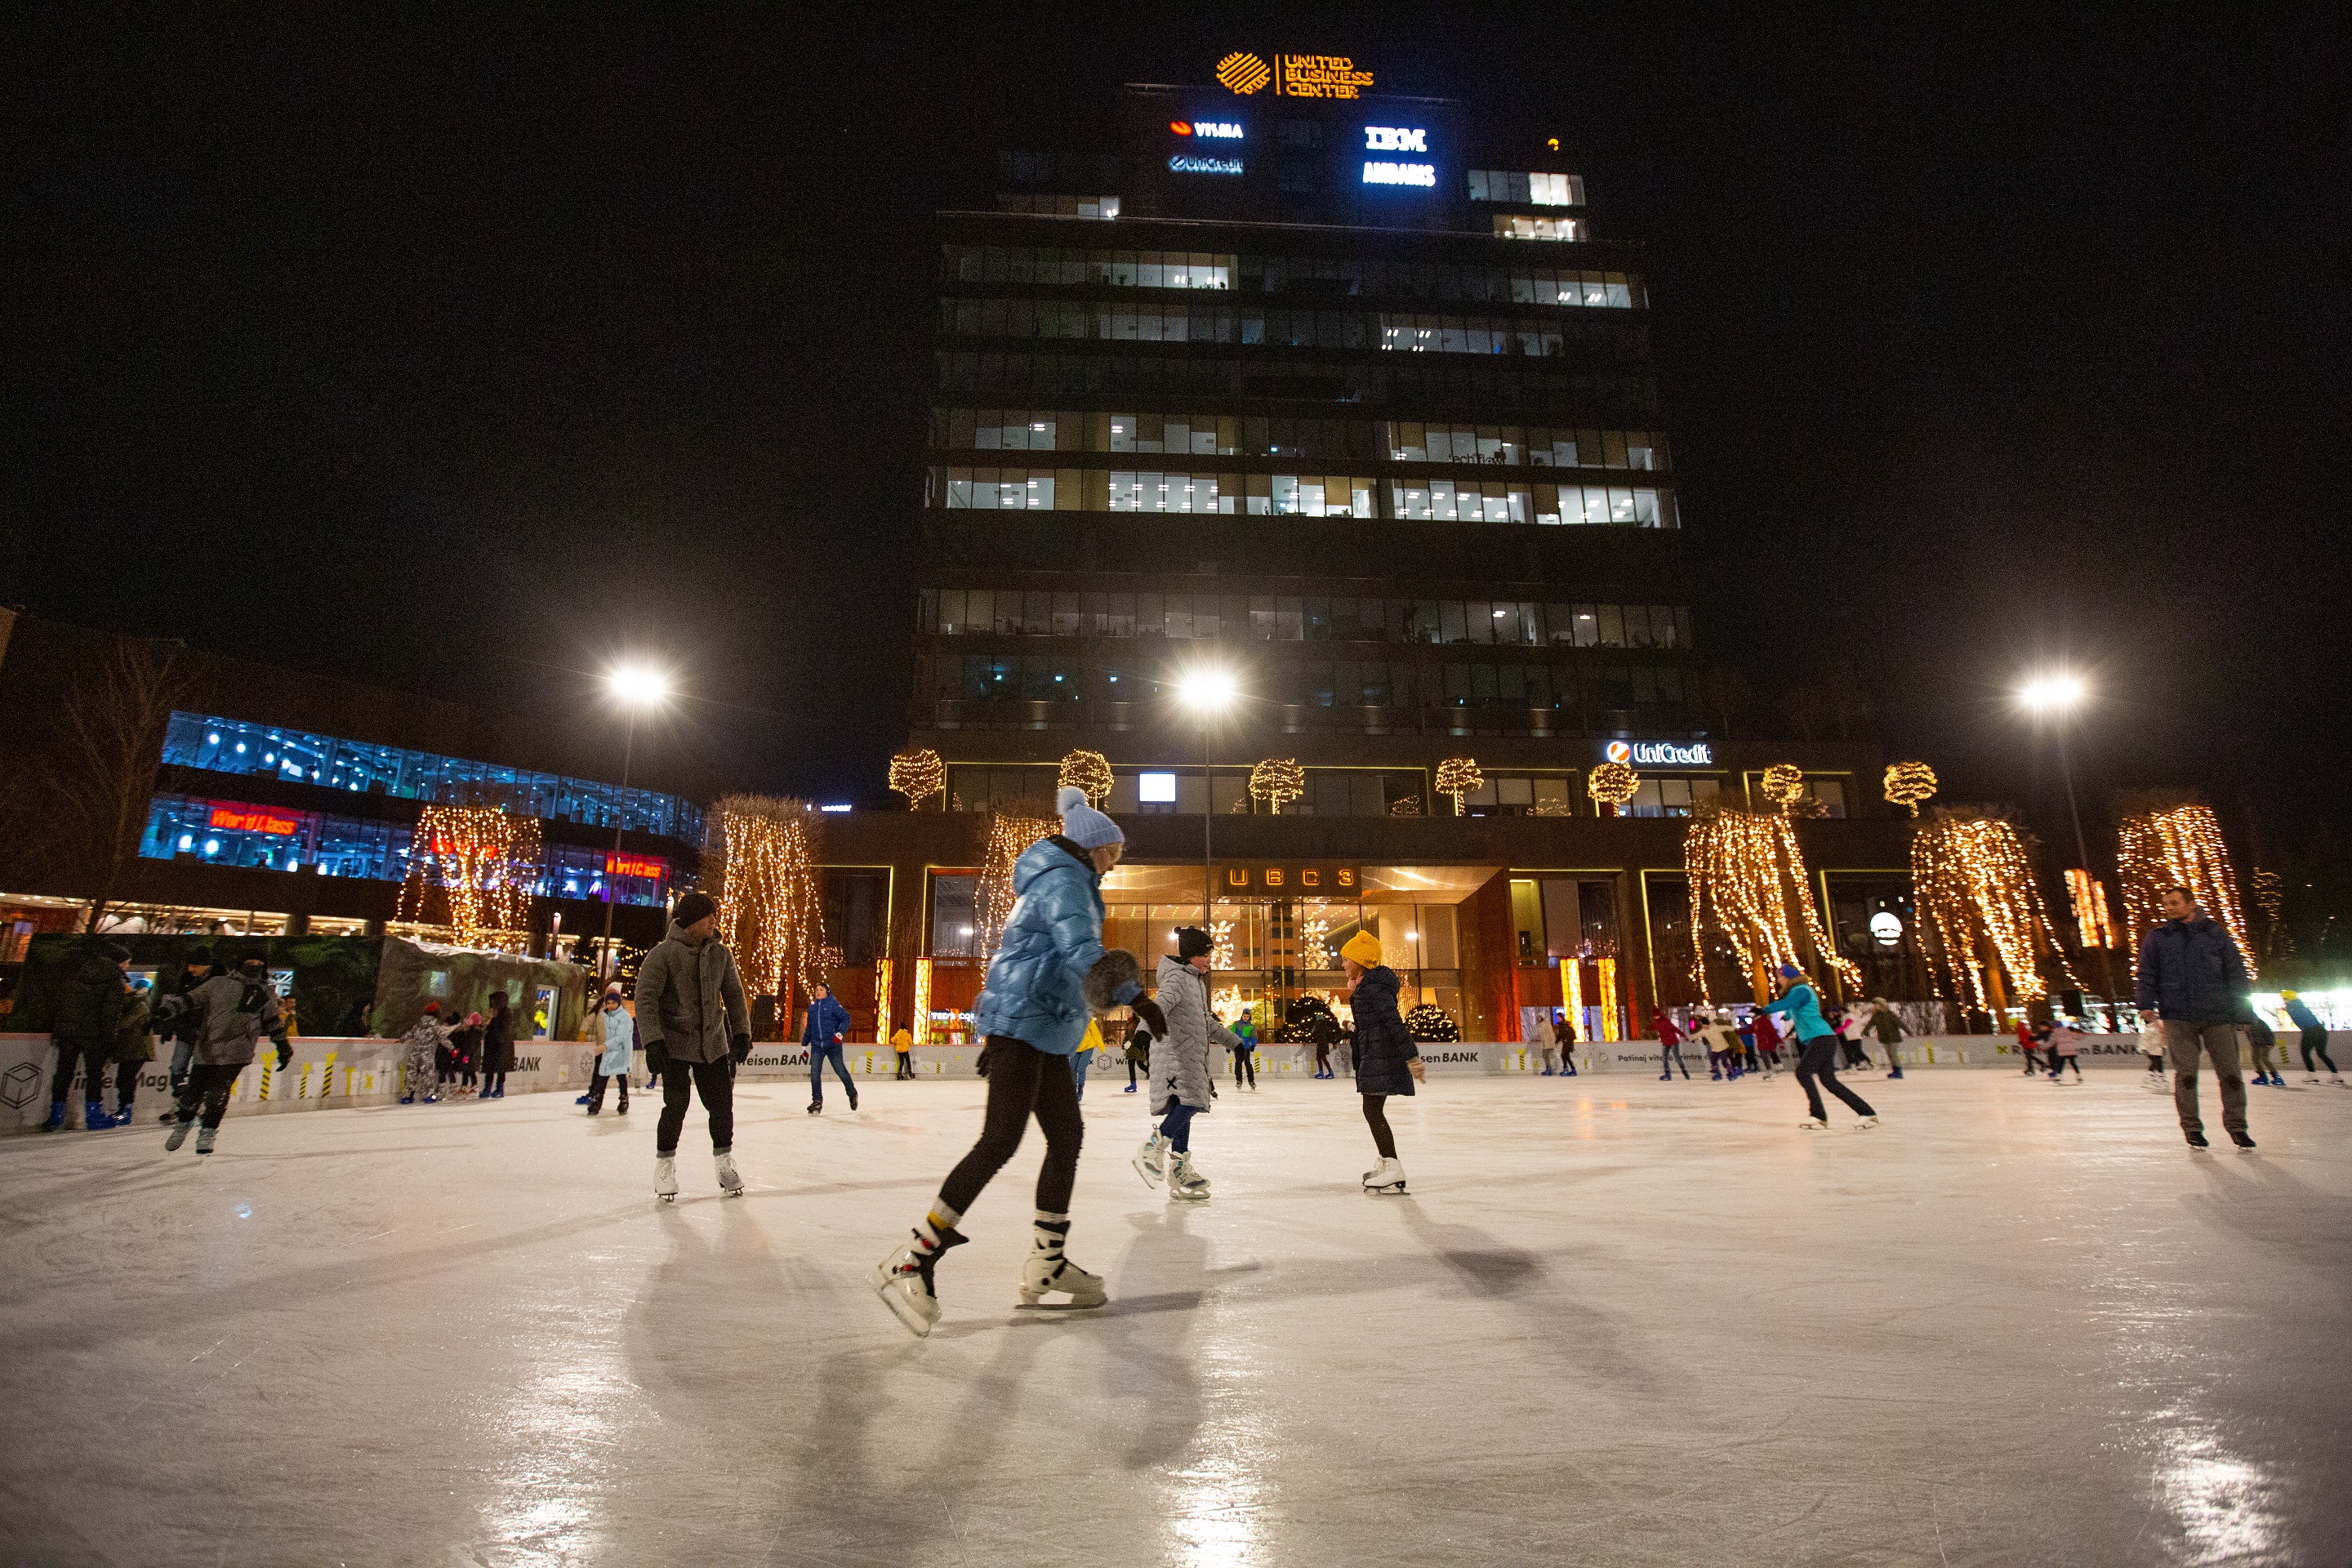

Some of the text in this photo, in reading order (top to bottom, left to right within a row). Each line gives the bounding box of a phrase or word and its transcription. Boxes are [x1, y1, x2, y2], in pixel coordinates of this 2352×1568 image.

[1285, 54, 1354, 70] UNITED
[1285, 69, 1374, 86] BUSINESS
[1285, 82, 1360, 99] CENTER
[1365, 126, 1428, 153] IBM
[1633, 743, 1713, 764] UniCredit
[634, 862, 662, 878] Cass
[1618, 1054, 1646, 1063] Patinaj
